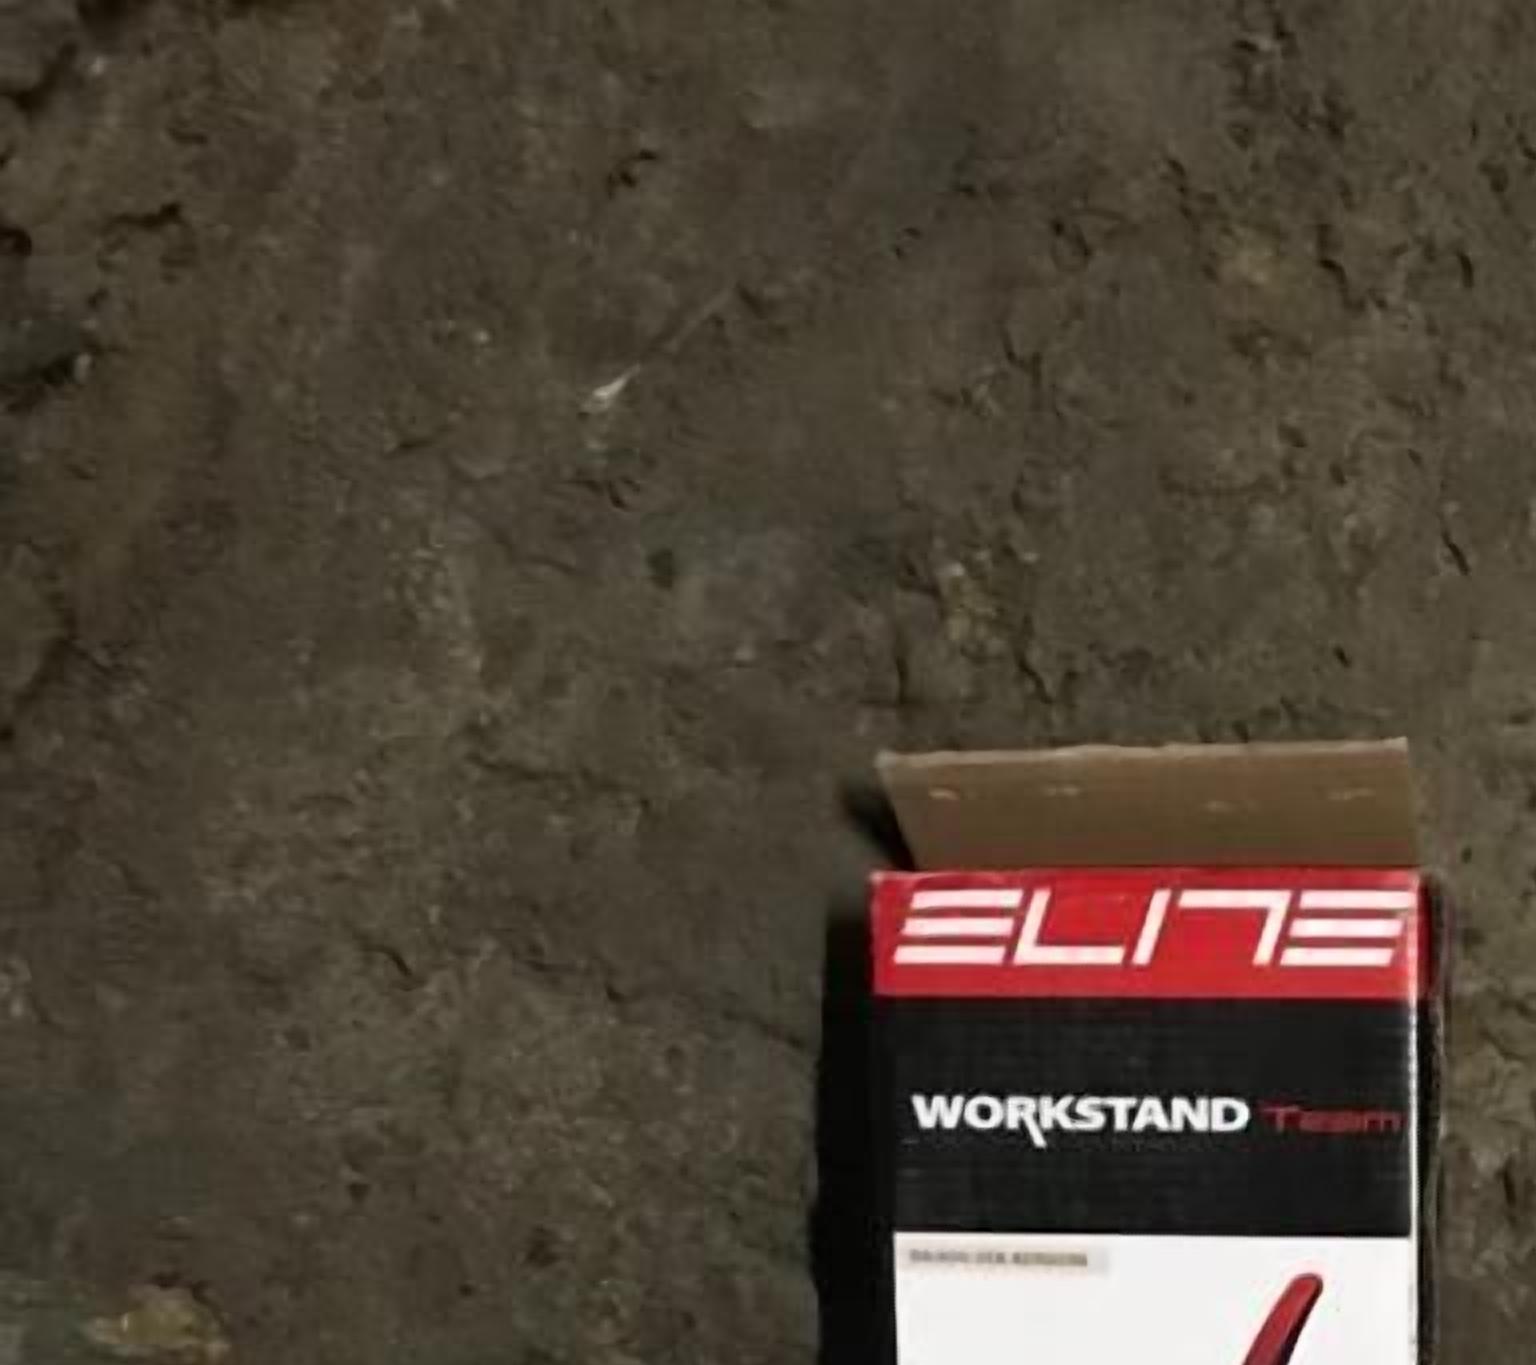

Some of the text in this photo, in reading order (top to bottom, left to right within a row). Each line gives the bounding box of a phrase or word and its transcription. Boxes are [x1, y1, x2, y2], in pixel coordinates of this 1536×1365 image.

[894, 889, 1417, 965] ELITE
[912, 1094, 1402, 1148] WORKSTAND Team
